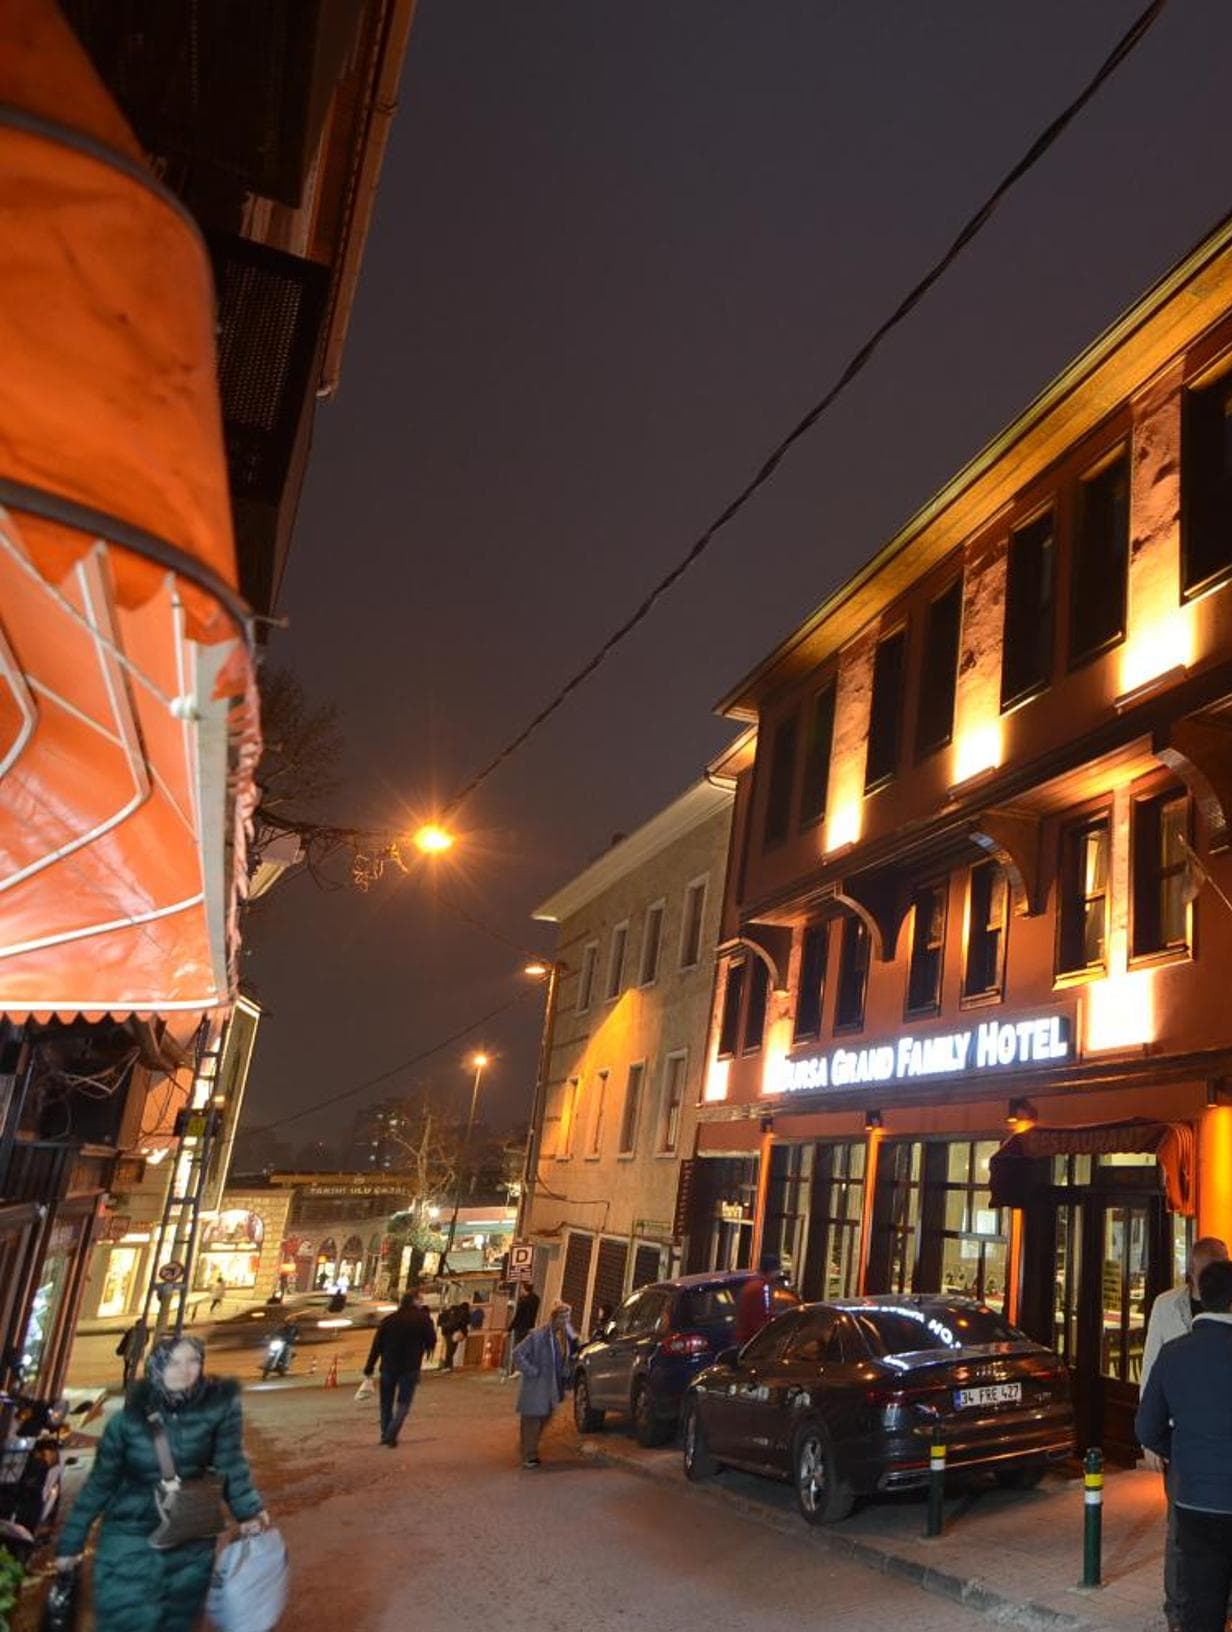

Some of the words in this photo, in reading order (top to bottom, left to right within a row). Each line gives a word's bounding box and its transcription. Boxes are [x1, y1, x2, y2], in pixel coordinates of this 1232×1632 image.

[831, 1049, 894, 1086] GRAND
[896, 1031, 972, 1078] FAMILY
[976, 1015, 1068, 1068] HOTEL
[962, 1391, 974, 1404] 34
[1001, 1384, 1019, 1398] 427
